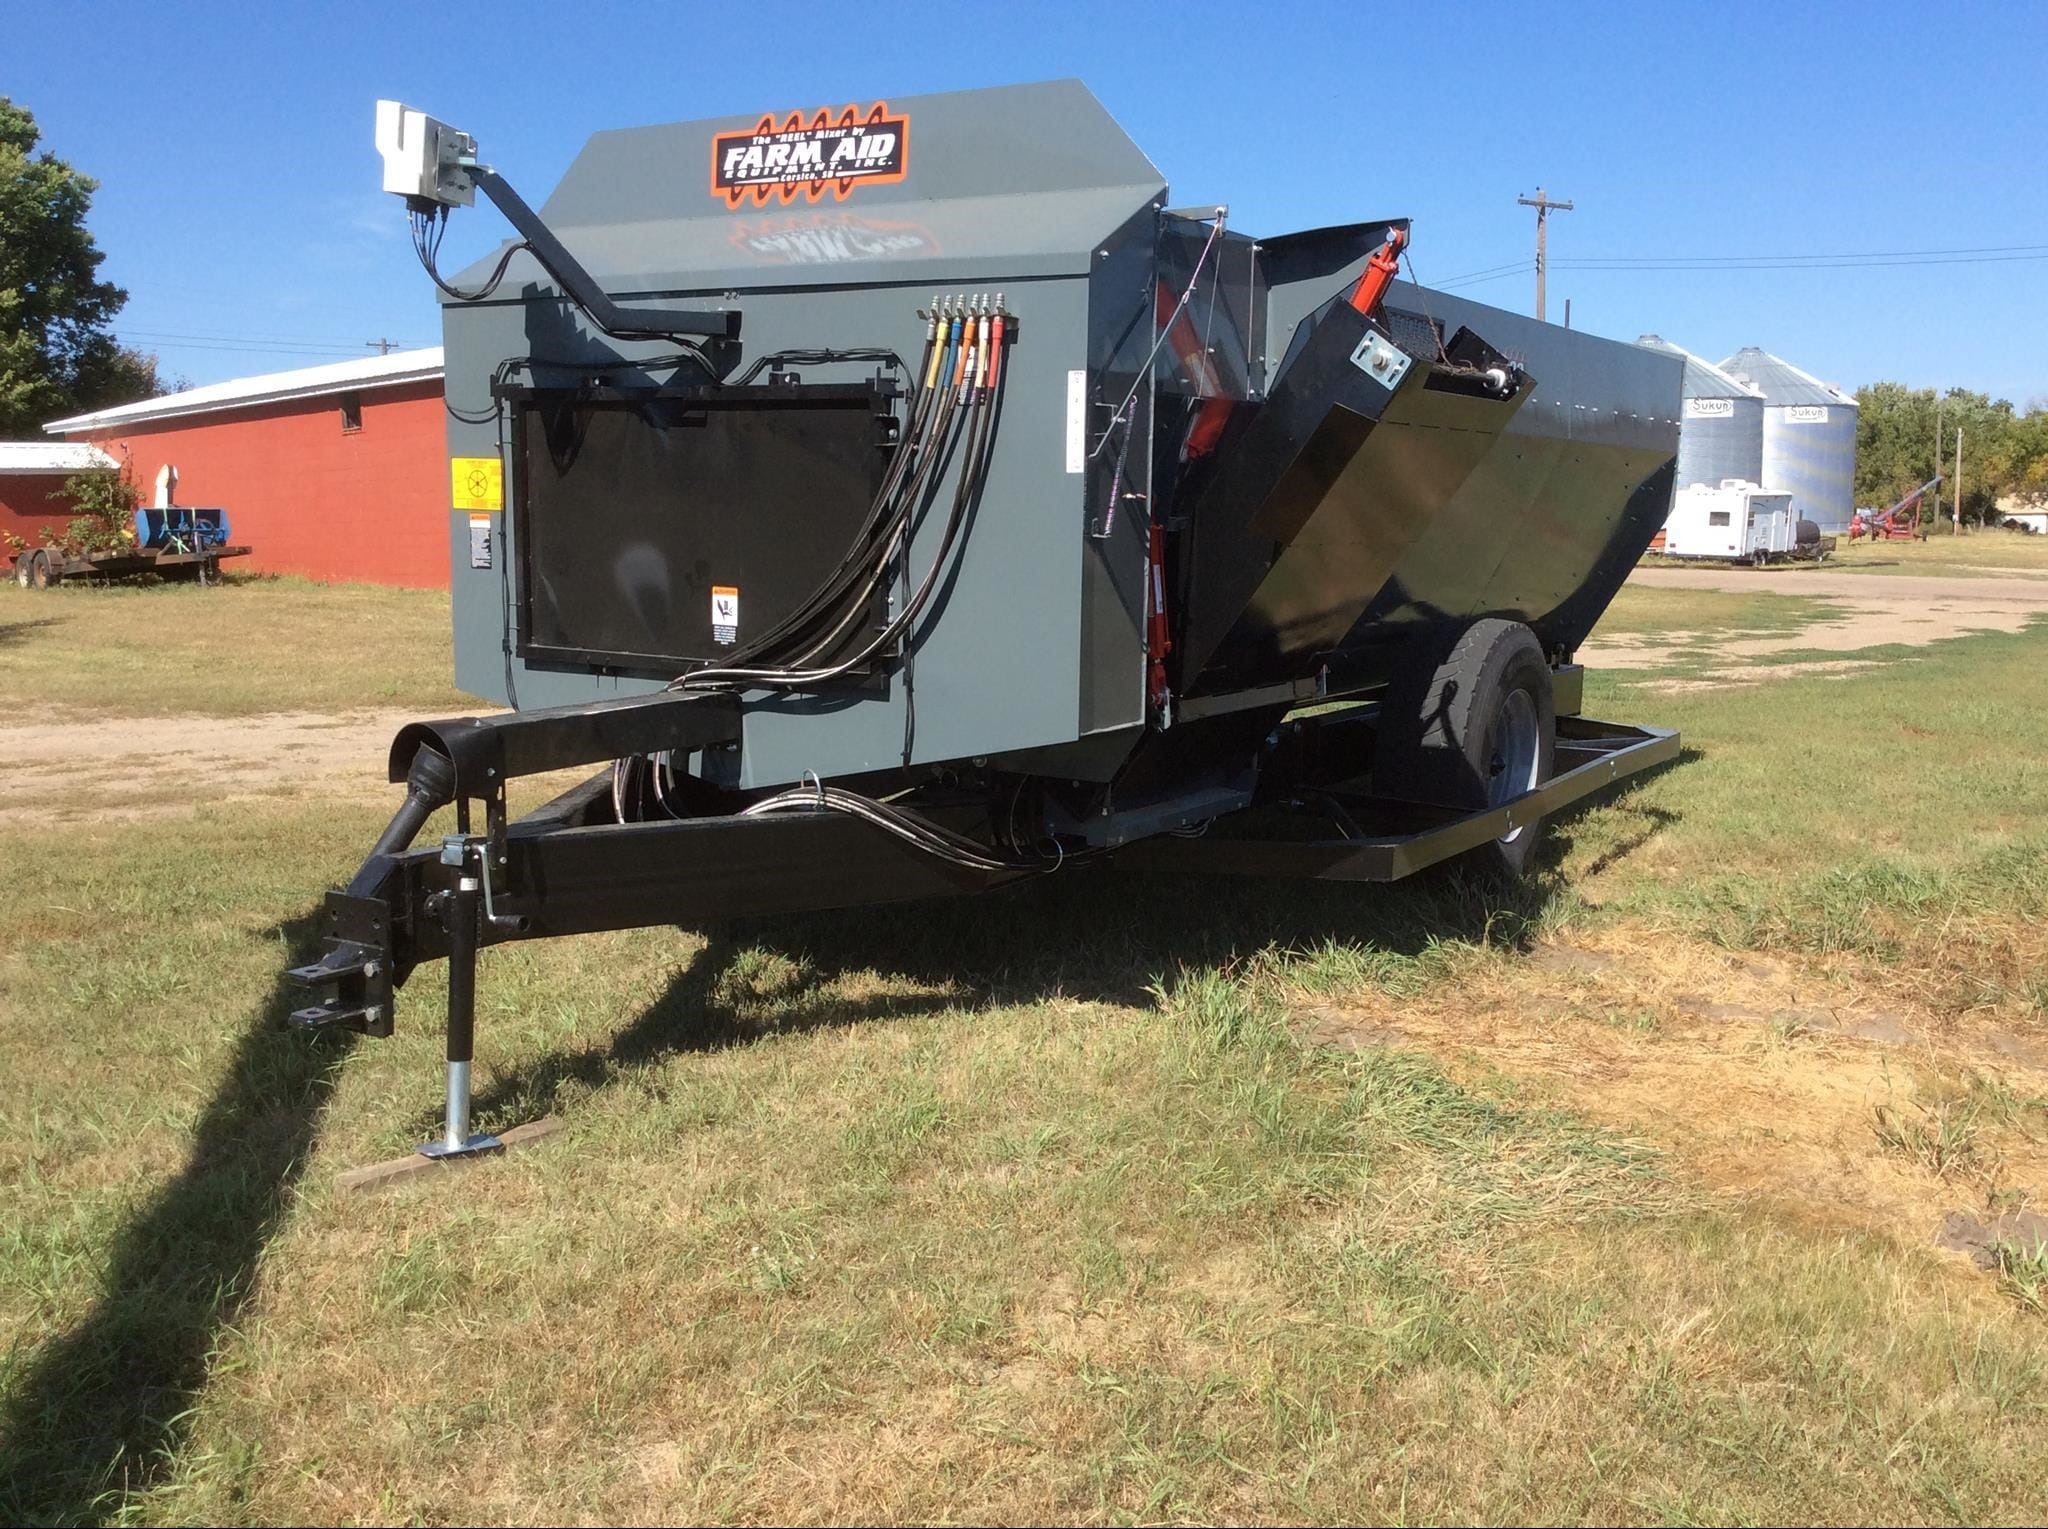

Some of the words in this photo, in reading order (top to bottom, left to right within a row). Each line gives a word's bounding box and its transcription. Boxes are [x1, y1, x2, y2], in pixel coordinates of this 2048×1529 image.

[752, 136, 771, 145] The
[815, 128, 847, 139] Mixer
[851, 126, 866, 136] by
[723, 140, 822, 171] FARM
[830, 133, 896, 162] AID
[854, 157, 893, 168] INC.
[821, 170, 834, 179] SD
